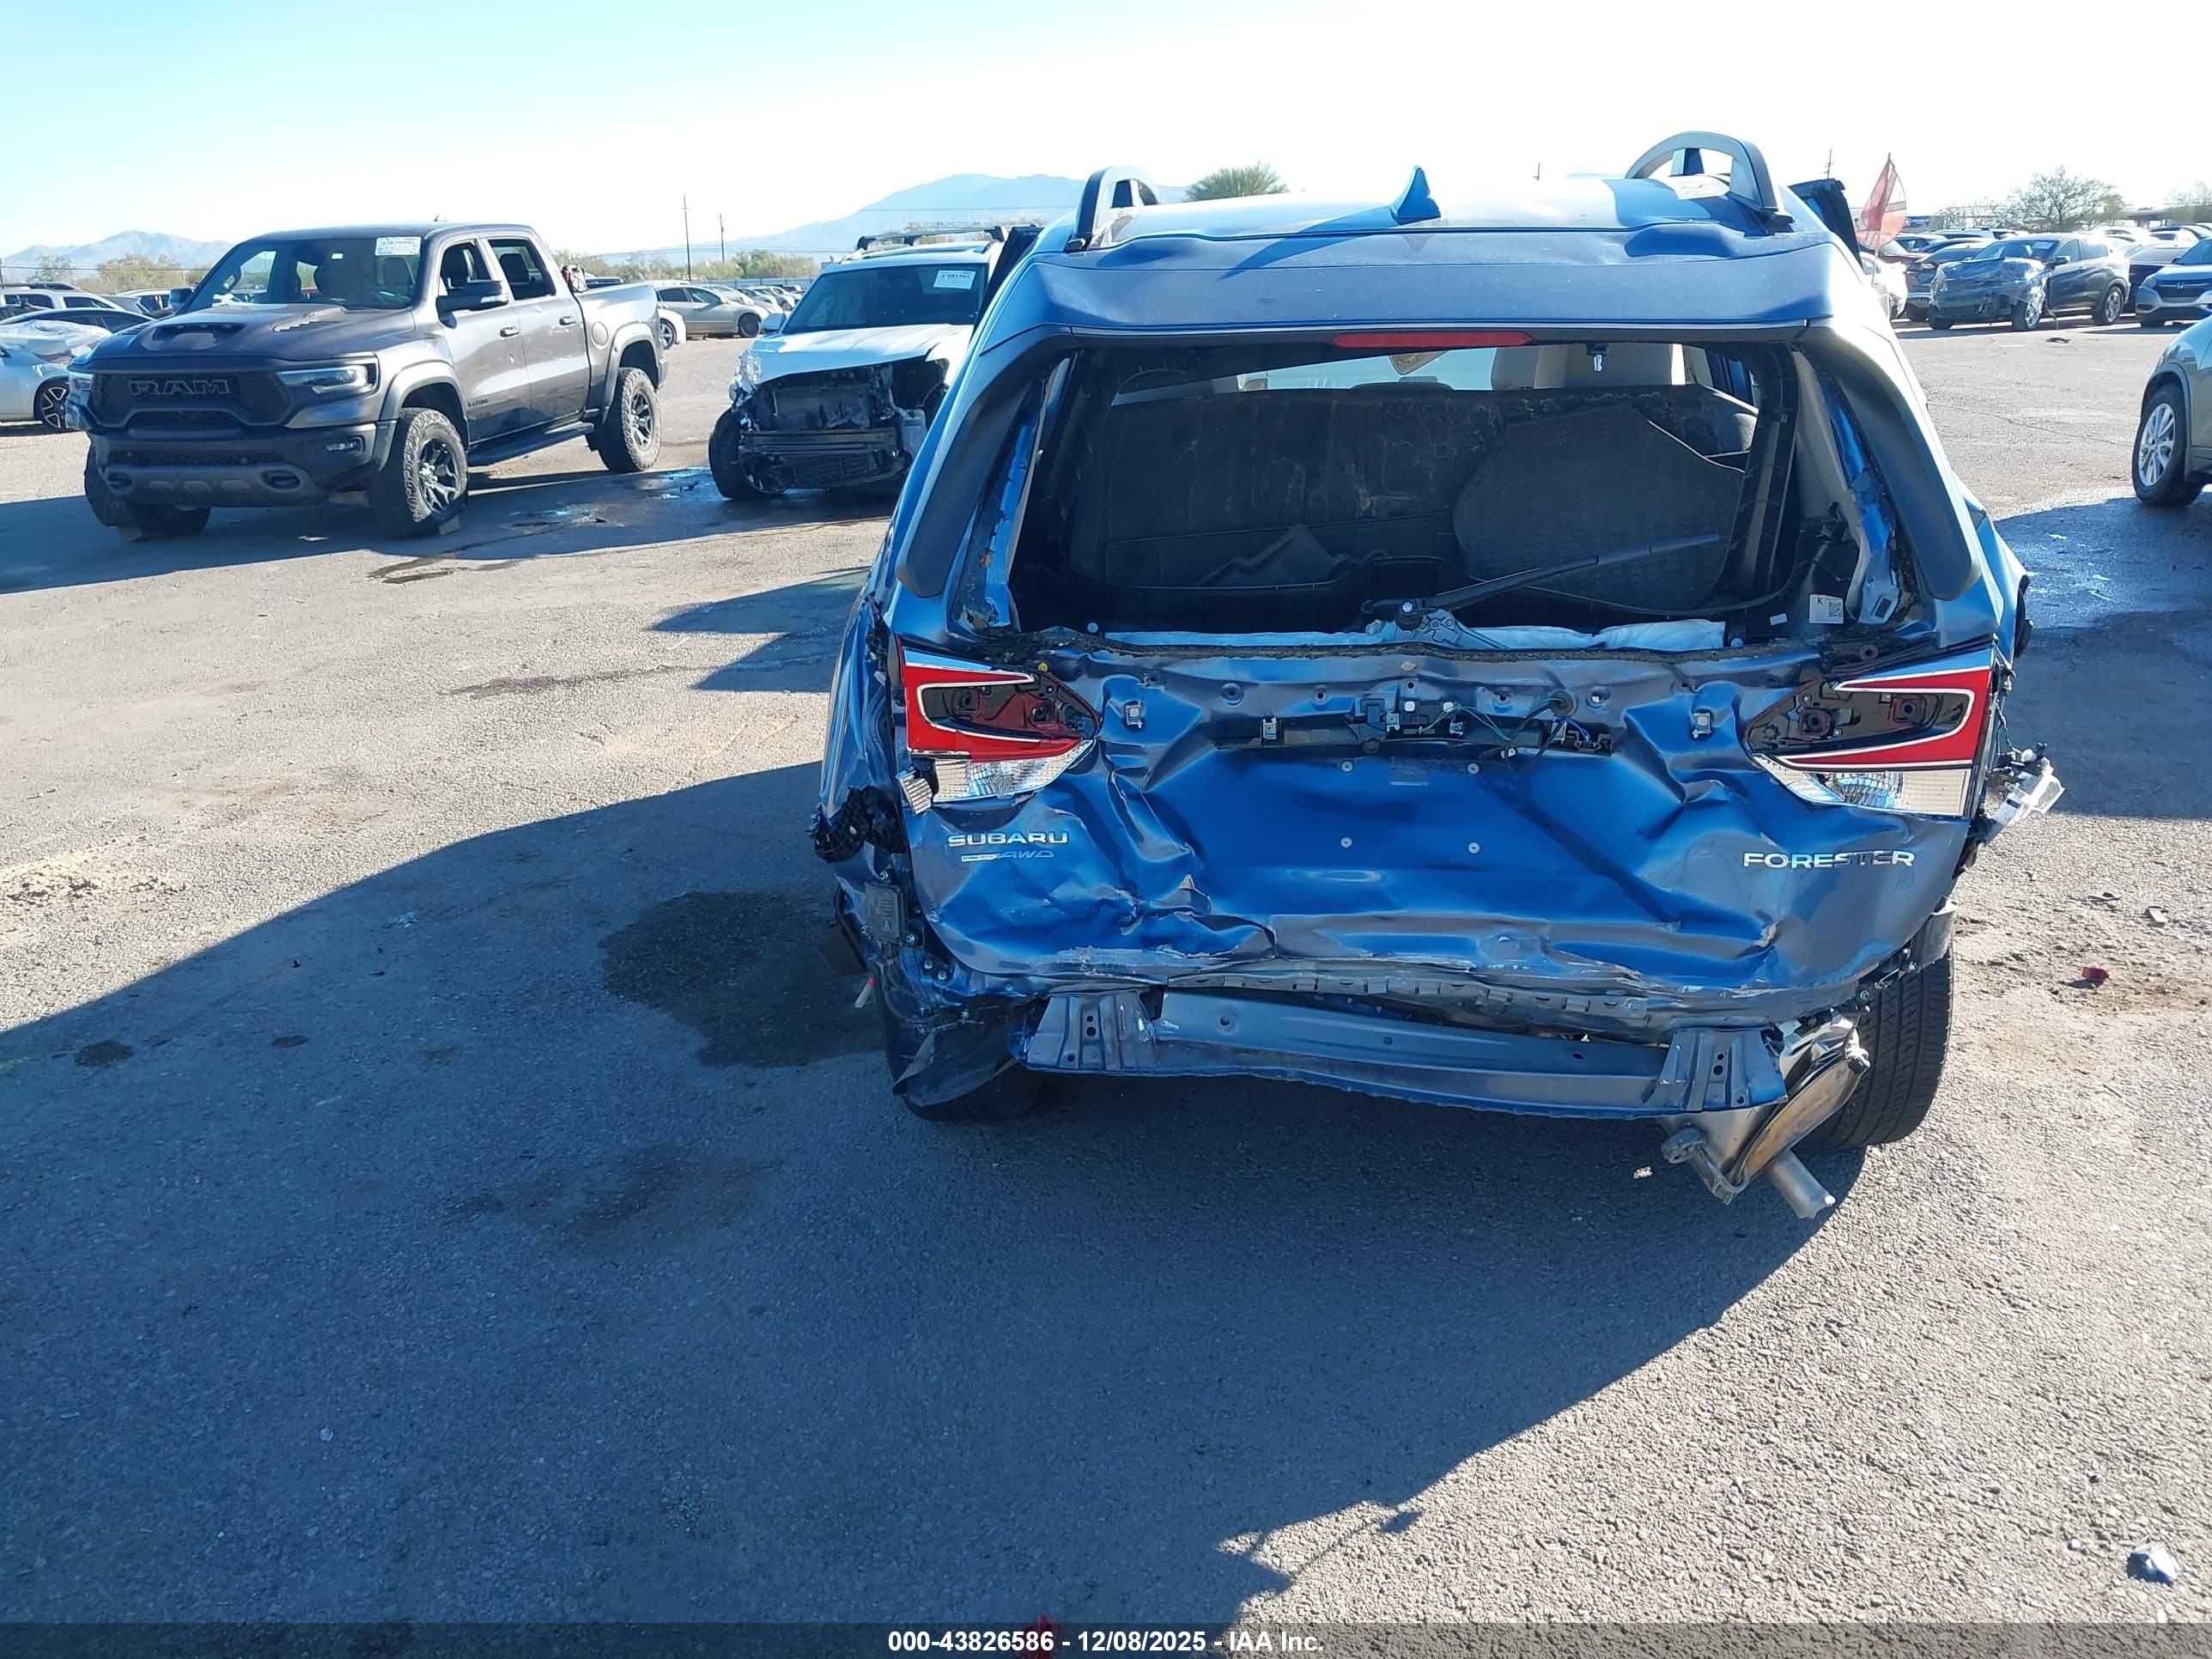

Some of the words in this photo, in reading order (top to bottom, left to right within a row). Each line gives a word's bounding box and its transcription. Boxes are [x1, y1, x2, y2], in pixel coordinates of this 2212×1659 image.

[129, 380, 229, 395] RAM
[1817, 597, 1824, 605] K
[947, 831, 1069, 848] SUBARU
[997, 850, 1054, 860] AWD
[1743, 850, 1916, 869] FORESTER
